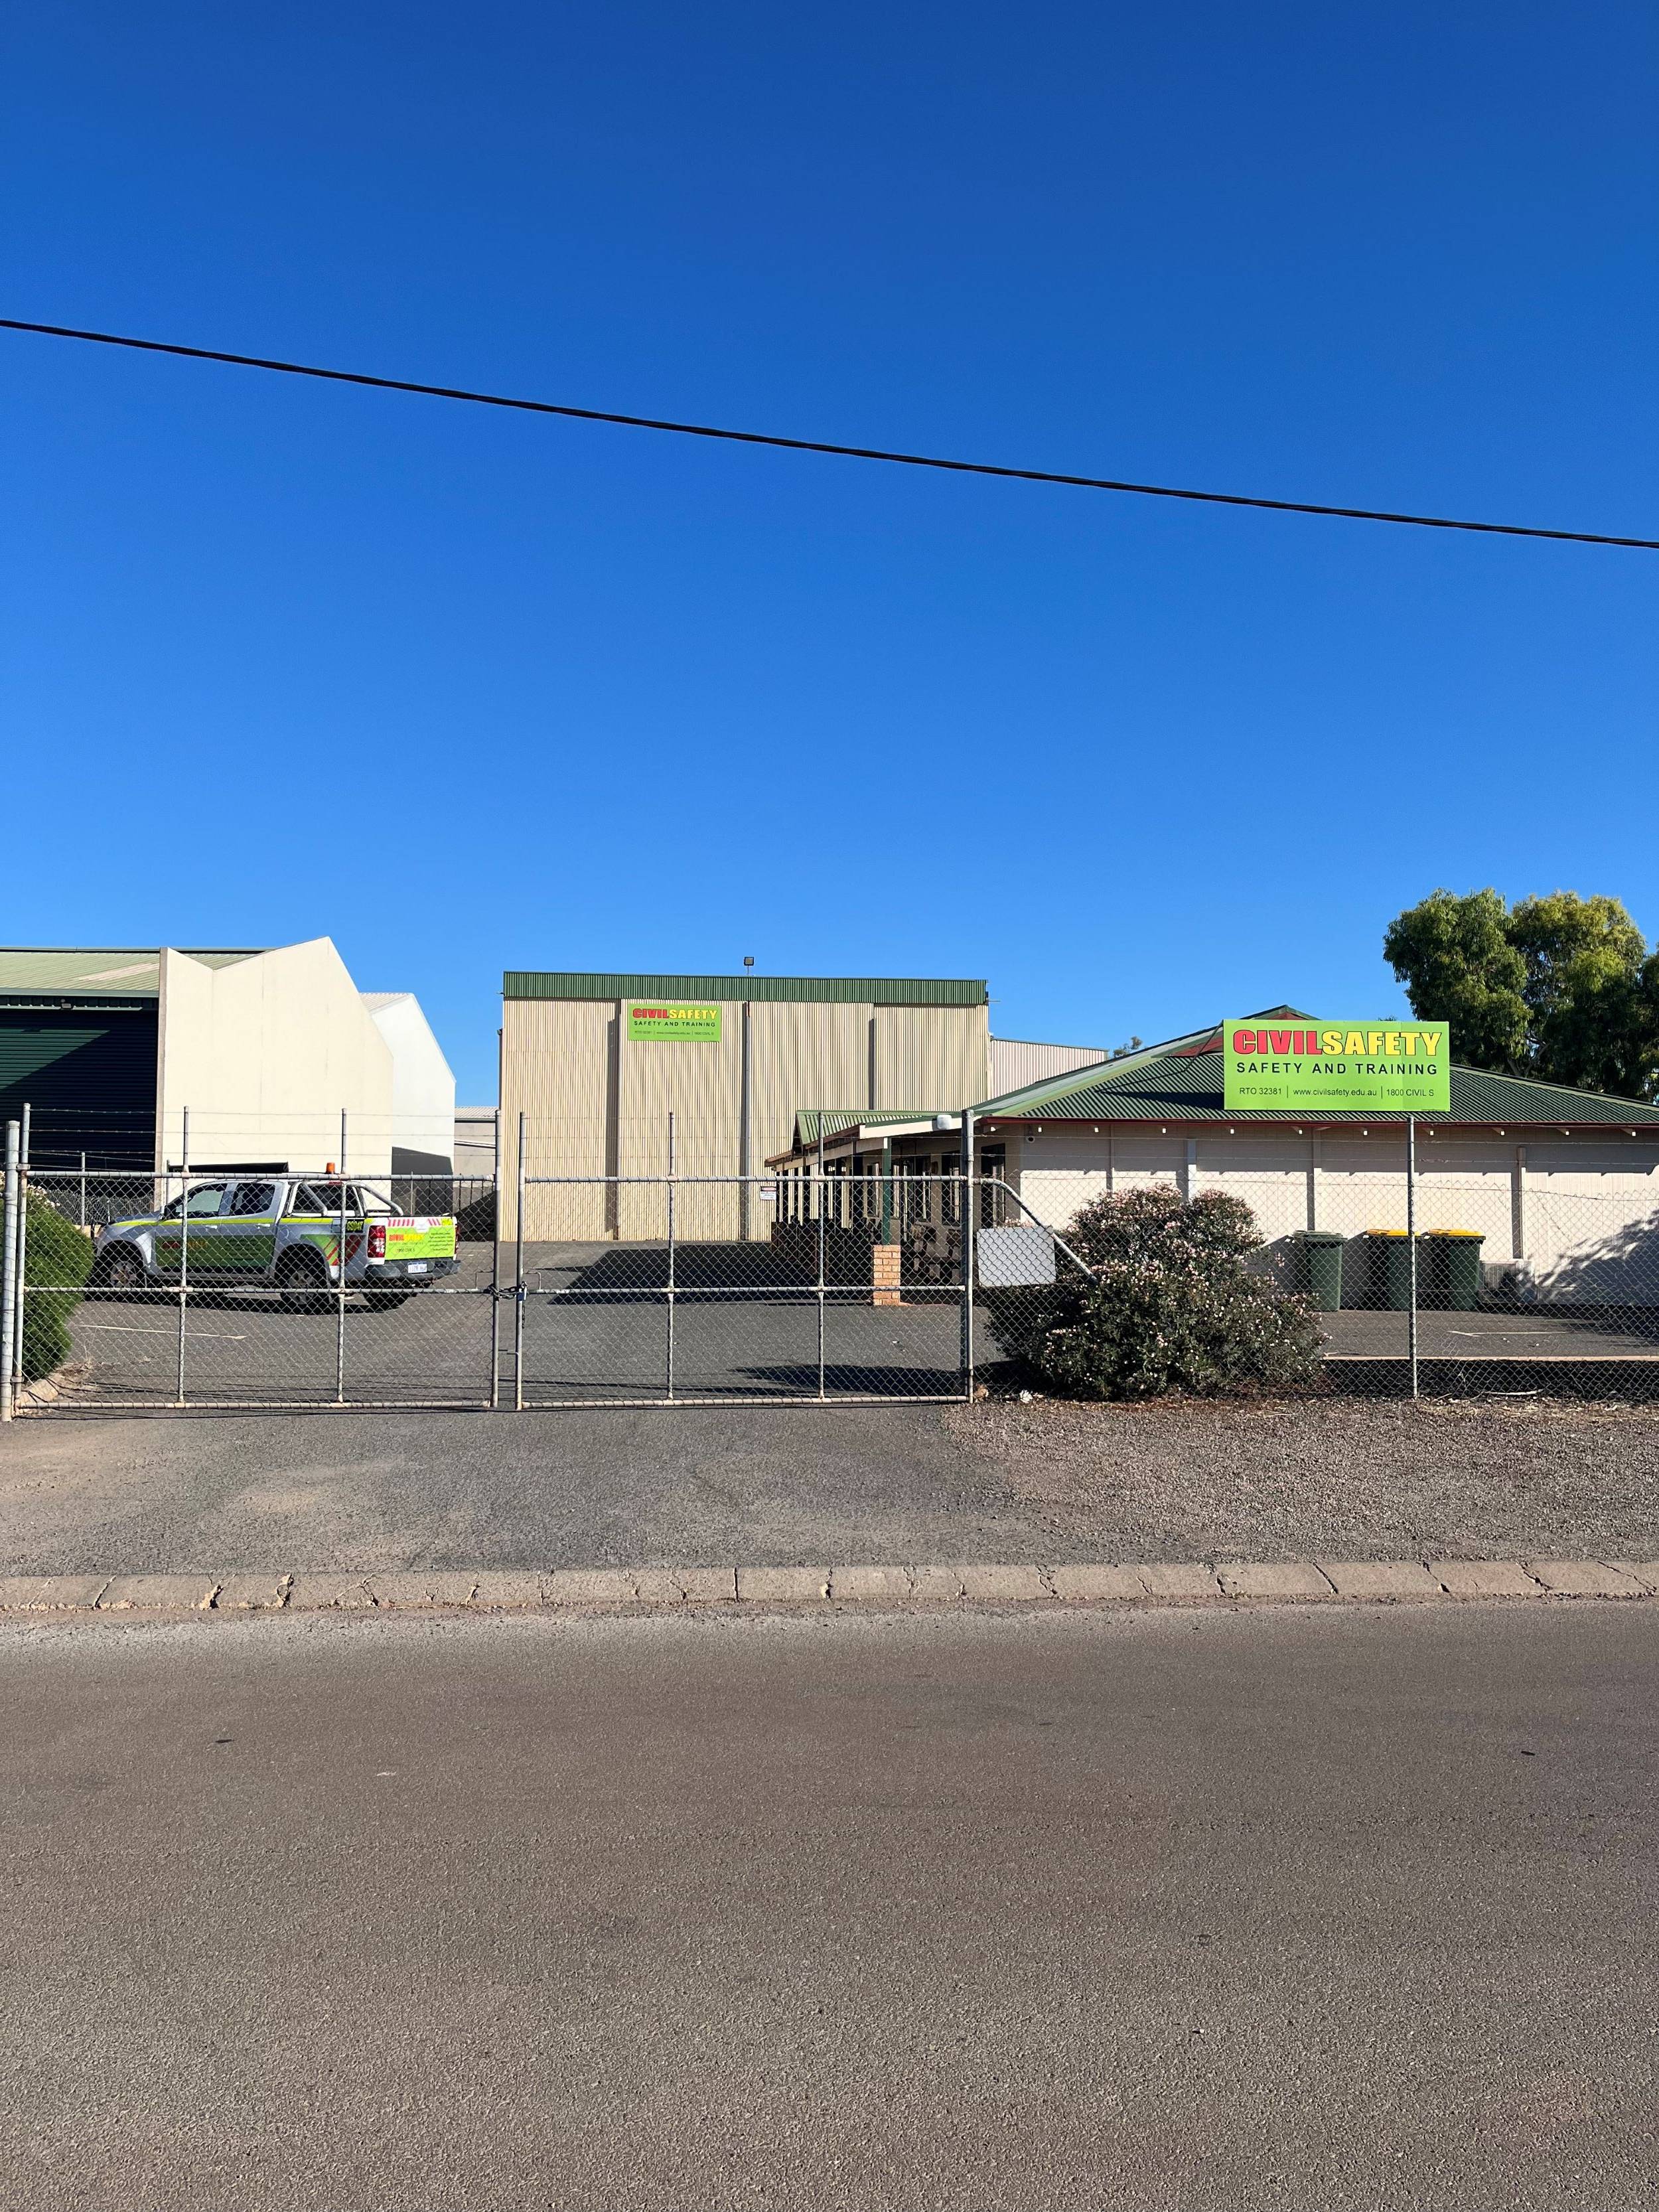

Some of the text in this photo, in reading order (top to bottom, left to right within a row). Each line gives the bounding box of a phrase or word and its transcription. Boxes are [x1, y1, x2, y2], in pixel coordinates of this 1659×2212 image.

[632, 1008, 717, 1020] CIVILSAFETY
[1233, 1029, 1442, 1057] CIVILSAFETY
[1236, 1062, 1437, 1074] SAFETY AND TRAINING
[1293, 1088, 1377, 1097] www.civilsafety.edu.au
